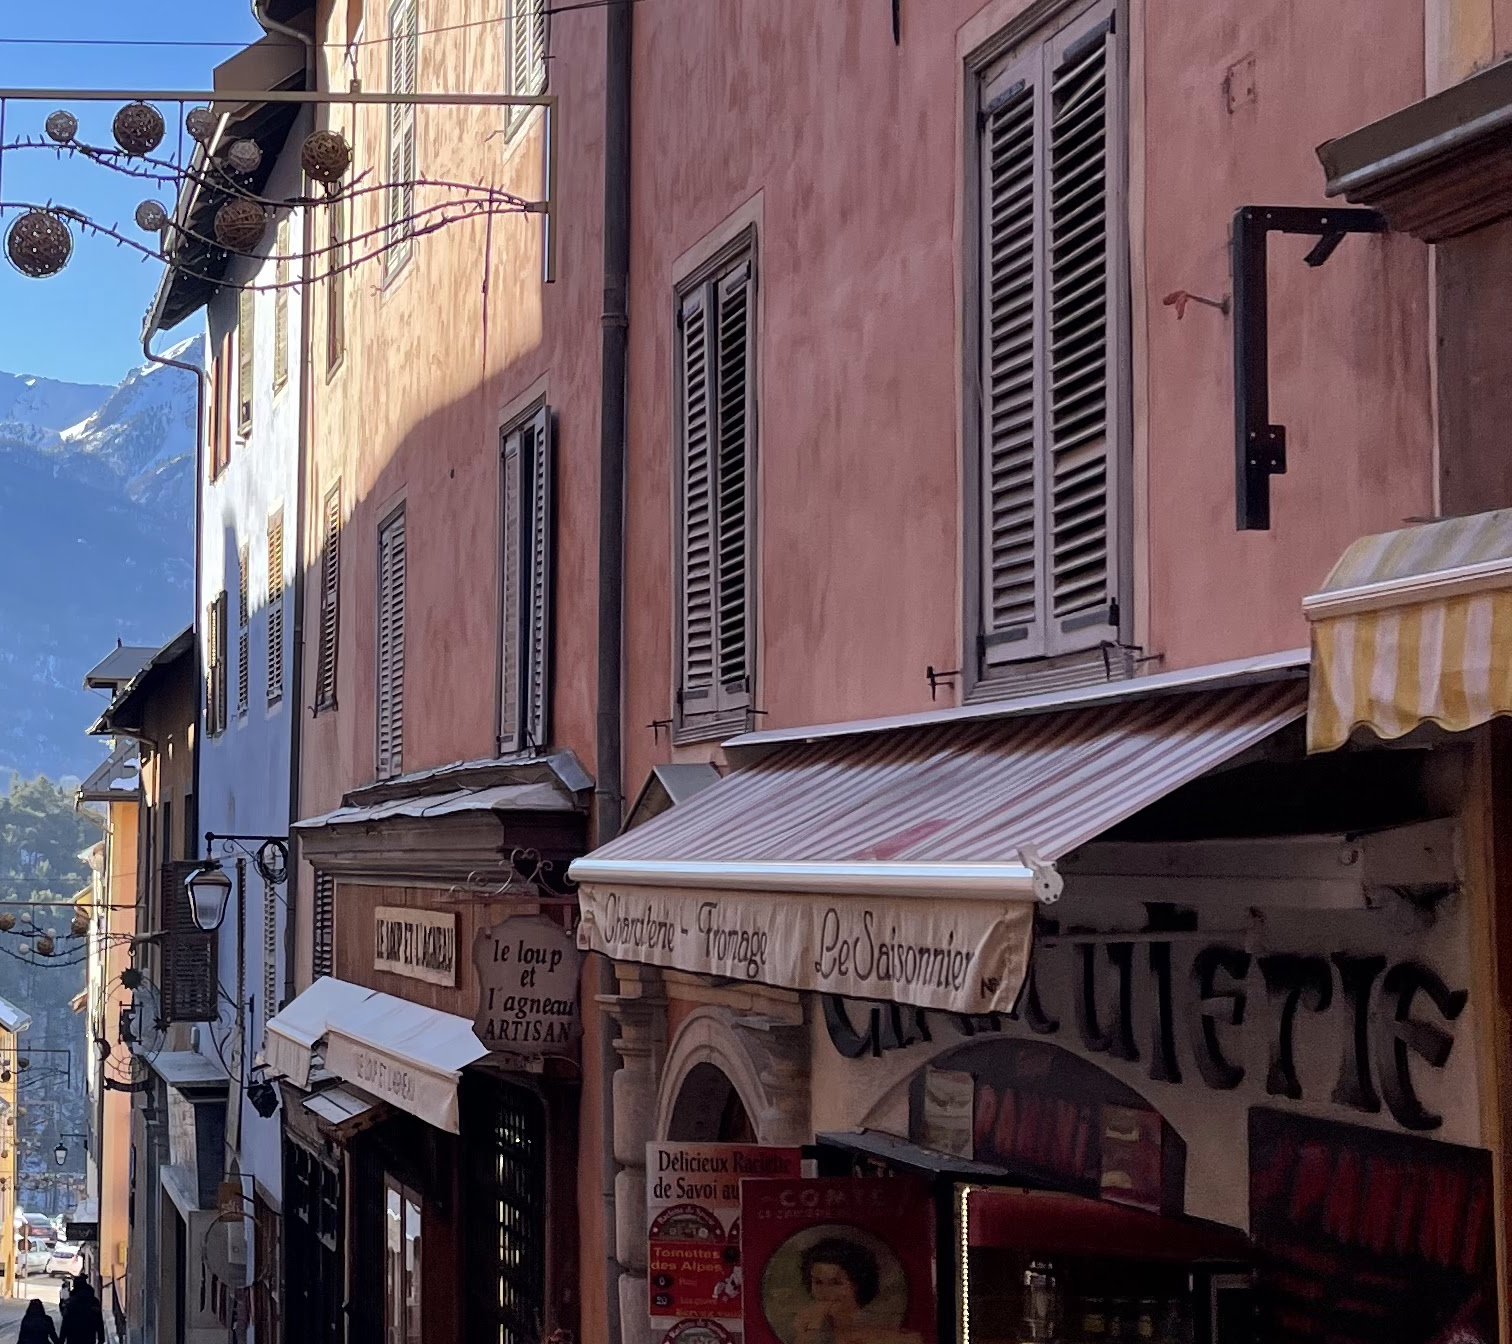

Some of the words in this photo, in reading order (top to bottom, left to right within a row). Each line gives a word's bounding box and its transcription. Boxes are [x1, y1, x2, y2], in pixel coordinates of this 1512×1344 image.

[493, 939, 511, 963] le
[517, 940, 563, 973] loup
[697, 901, 768, 979] Fromage
[852, 910, 975, 993] Saisonnier
[520, 966, 536, 988] et
[485, 1019, 572, 1043] ARTISAN
[653, 1176, 672, 1199] de
[676, 1177, 717, 1200] Savoi
